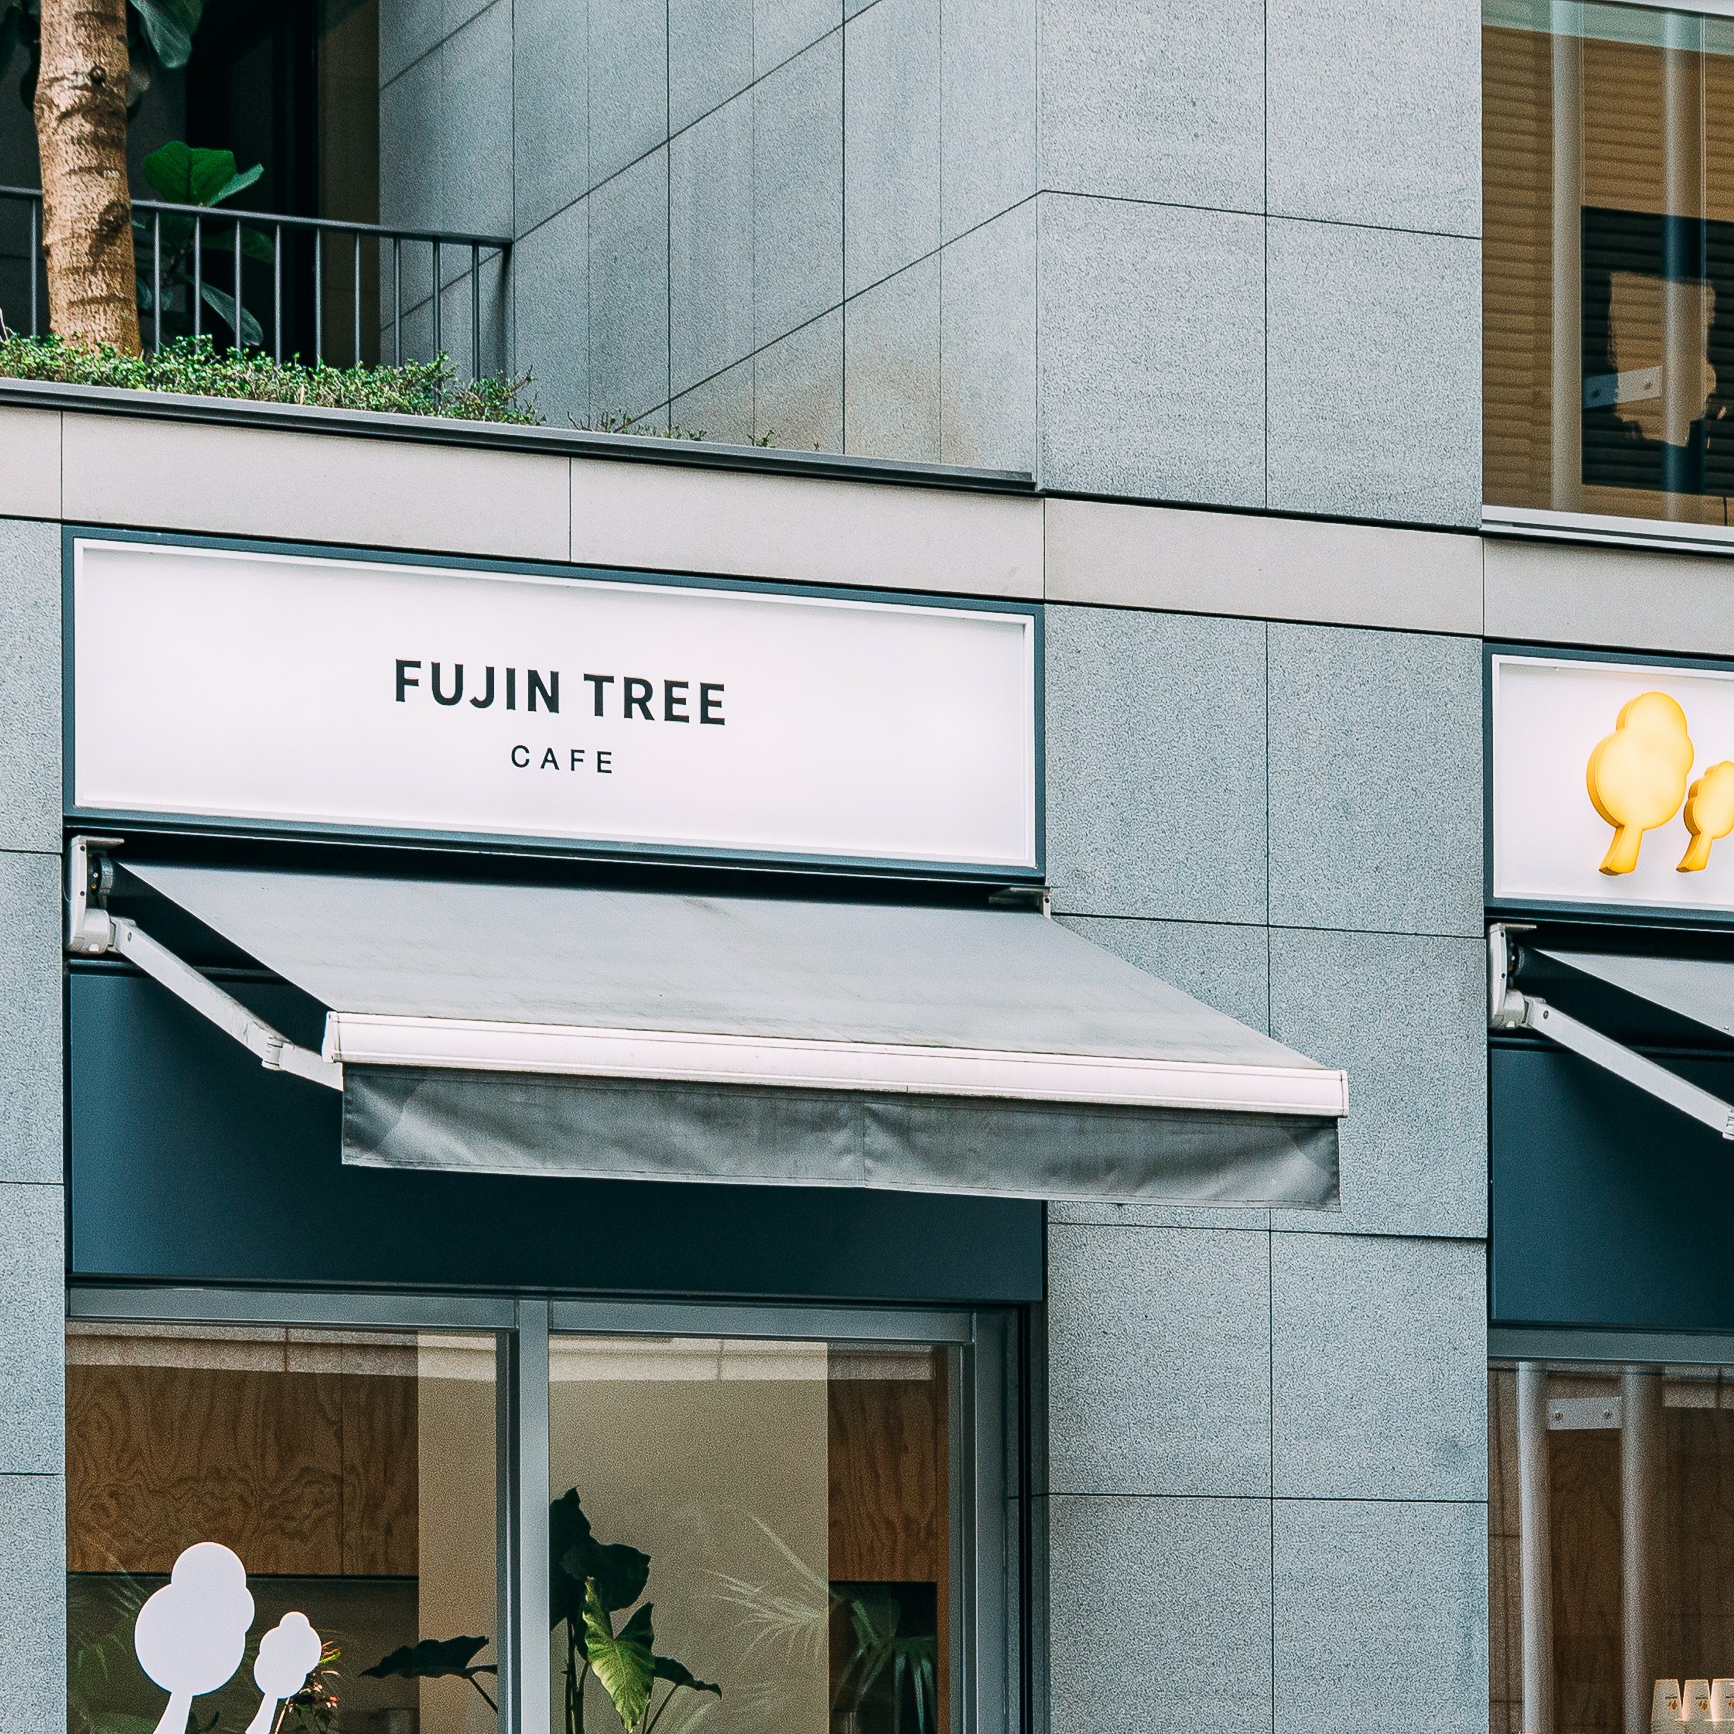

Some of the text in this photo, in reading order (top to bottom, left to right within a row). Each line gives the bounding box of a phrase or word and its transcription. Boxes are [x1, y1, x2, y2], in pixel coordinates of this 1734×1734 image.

[395, 658, 726, 726] FUJIN TREE
[511, 744, 613, 774] CAFE
